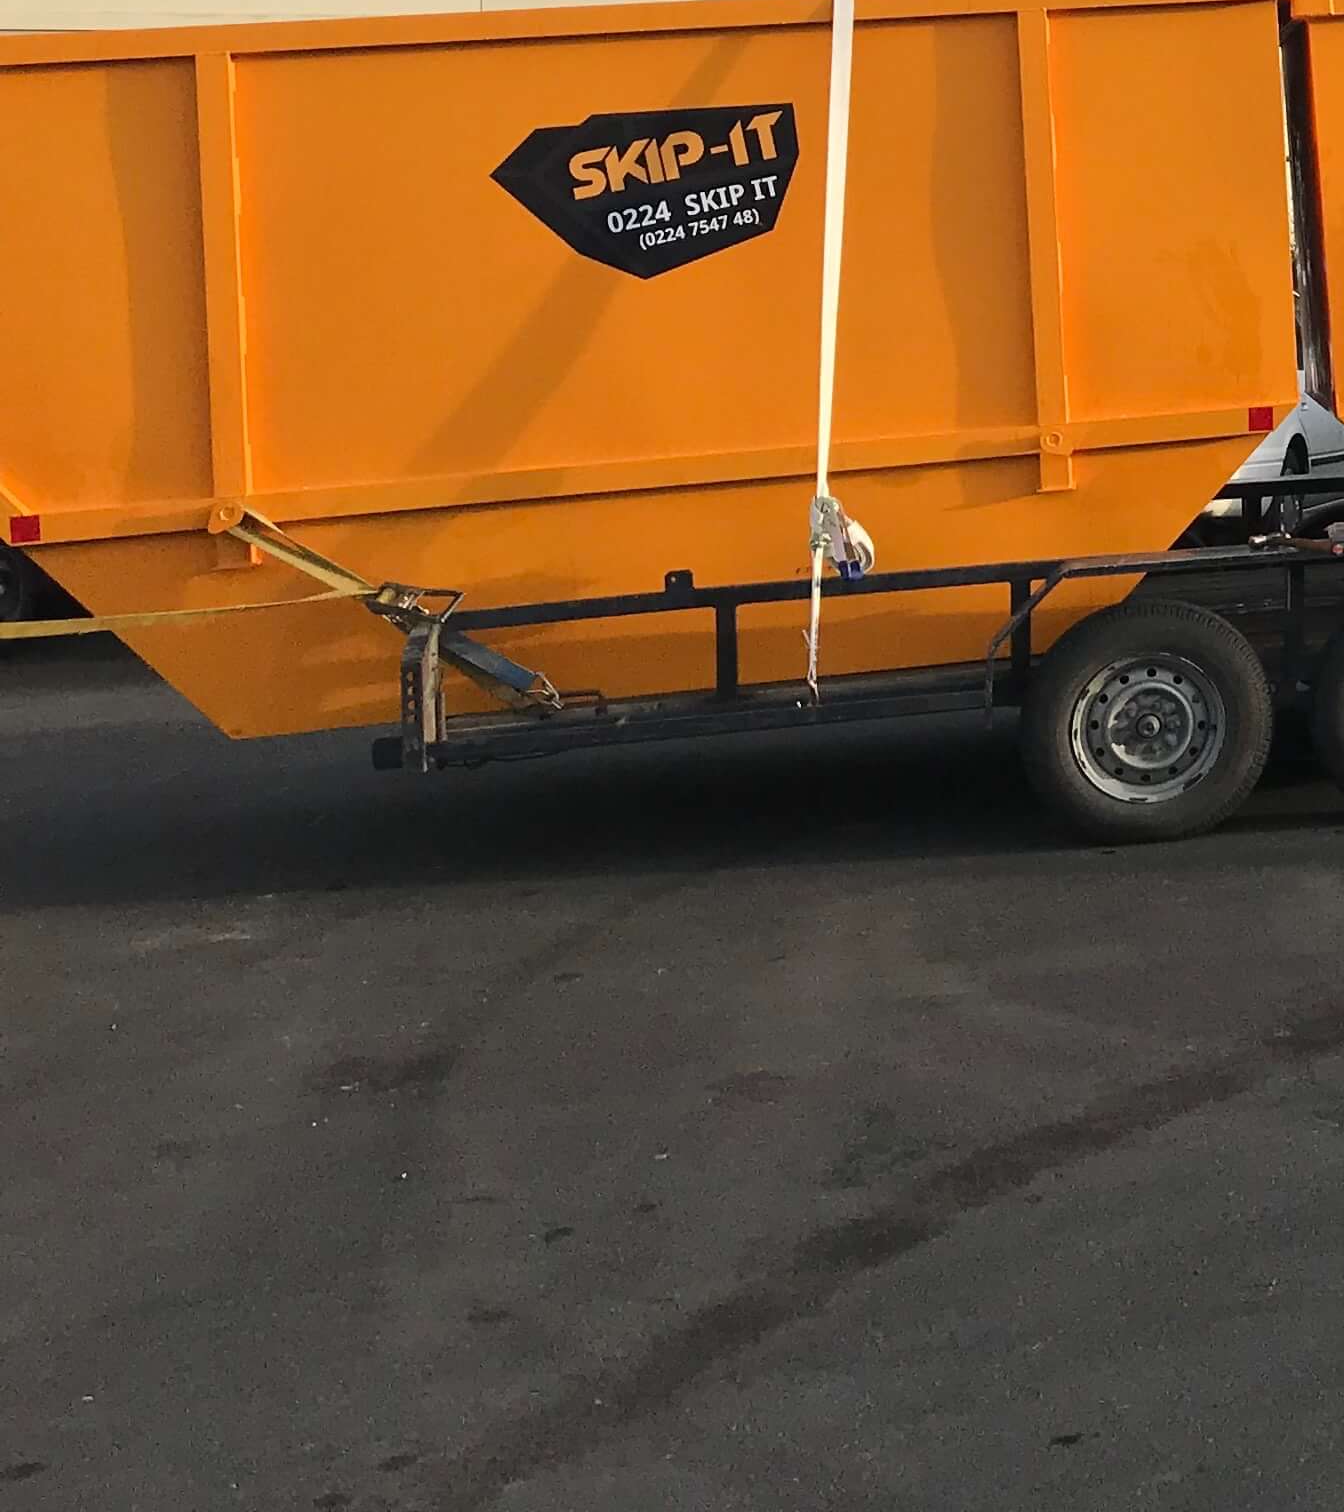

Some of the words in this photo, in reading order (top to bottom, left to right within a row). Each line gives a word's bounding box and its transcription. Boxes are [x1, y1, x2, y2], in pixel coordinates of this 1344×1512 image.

[569, 110, 783, 200] SKIP-IT
[607, 201, 671, 233] 0224
[684, 184, 745, 216] SKIP
[751, 175, 778, 201] IT
[639, 227, 686, 250] (0224
[688, 215, 729, 237] 7547
[733, 207, 760, 226] 48)
